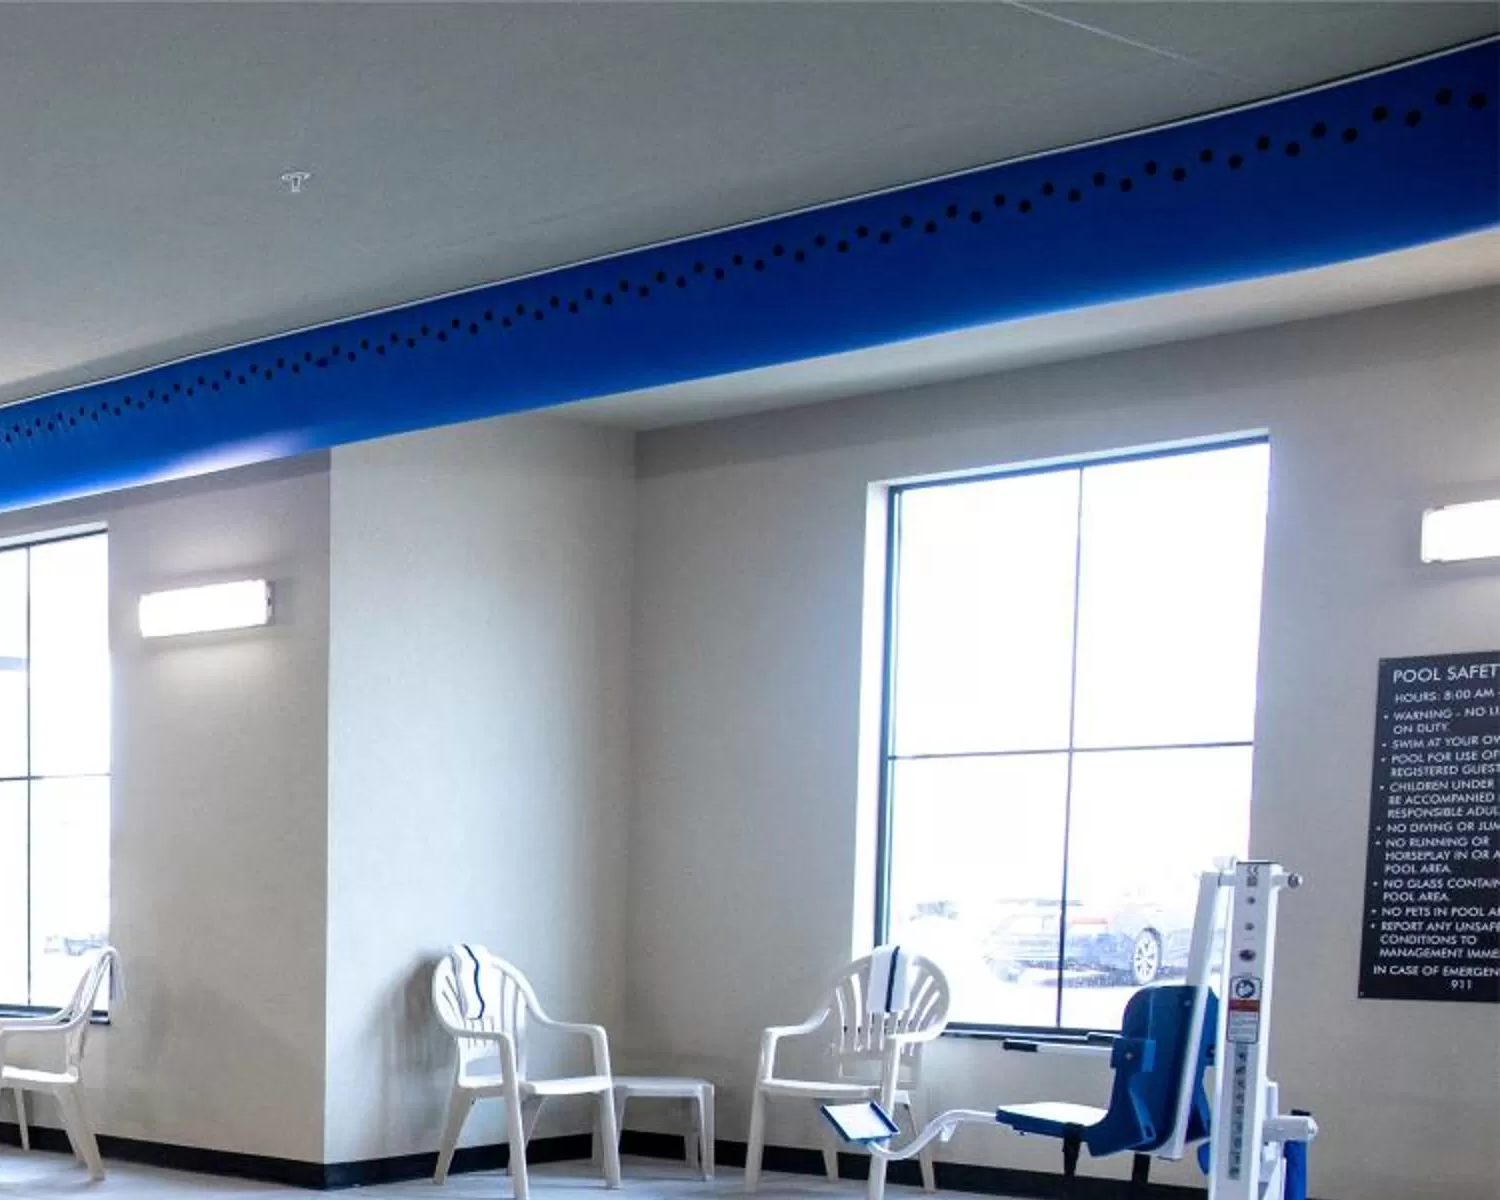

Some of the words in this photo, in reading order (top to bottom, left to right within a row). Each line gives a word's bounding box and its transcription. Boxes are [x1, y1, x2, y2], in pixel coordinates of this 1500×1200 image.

[1393, 668, 1441, 683] POOL
[1473, 687, 1495, 699] AM
[1393, 708, 1452, 721] WARNING
[1464, 706, 1485, 718] NO
[1393, 724, 1413, 735] ON
[1392, 738, 1424, 750] SWIM
[1427, 738, 1441, 748] AT
[1444, 735, 1479, 747] YOUR
[1391, 753, 1424, 765] POOL
[1427, 752, 1452, 763] FOR
[1455, 750, 1478, 761] USE
[1390, 765, 1458, 777] REGISTERED
[1389, 780, 1448, 793] CHILDREN
[1451, 779, 1495, 790] UNDER
[1388, 795, 1400, 805] BE
[1404, 792, 1495, 805] ACCOMPANIED
[1387, 806, 1463, 819] RESPONSIBLE
[1387, 823, 1406, 833] NO
[1410, 822, 1453, 834] DIVING
[1456, 821, 1475, 832] OR
[1385, 838, 1406, 848] NO
[1409, 836, 1468, 848] RUNNING
[1471, 835, 1490, 847] OR
[1385, 850, 1450, 862] HORSEPLAY
[1453, 849, 1468, 860] IN
[1471, 849, 1490, 860] OR
[1384, 864, 1416, 875] POOL
[1383, 879, 1403, 889] NO
[1407, 878, 1444, 889] GLASS
[1383, 891, 1415, 902] POOL
[1381, 906, 1402, 917] NO
[1405, 906, 1431, 917] PETS
[1433, 906, 1448, 916] IN
[1451, 906, 1485, 917] POOL
[1381, 921, 1423, 932] REPORT
[1427, 921, 1453, 931] ANY
[1380, 934, 1457, 945] CONDITIONS
[1461, 935, 1477, 945] TO
[1380, 948, 1464, 959] MANAGEMENT
[1373, 965, 1387, 975] IN
[1389, 965, 1419, 976] CASE
[1422, 966, 1440, 976] OF
[1451, 979, 1472, 990] 911
